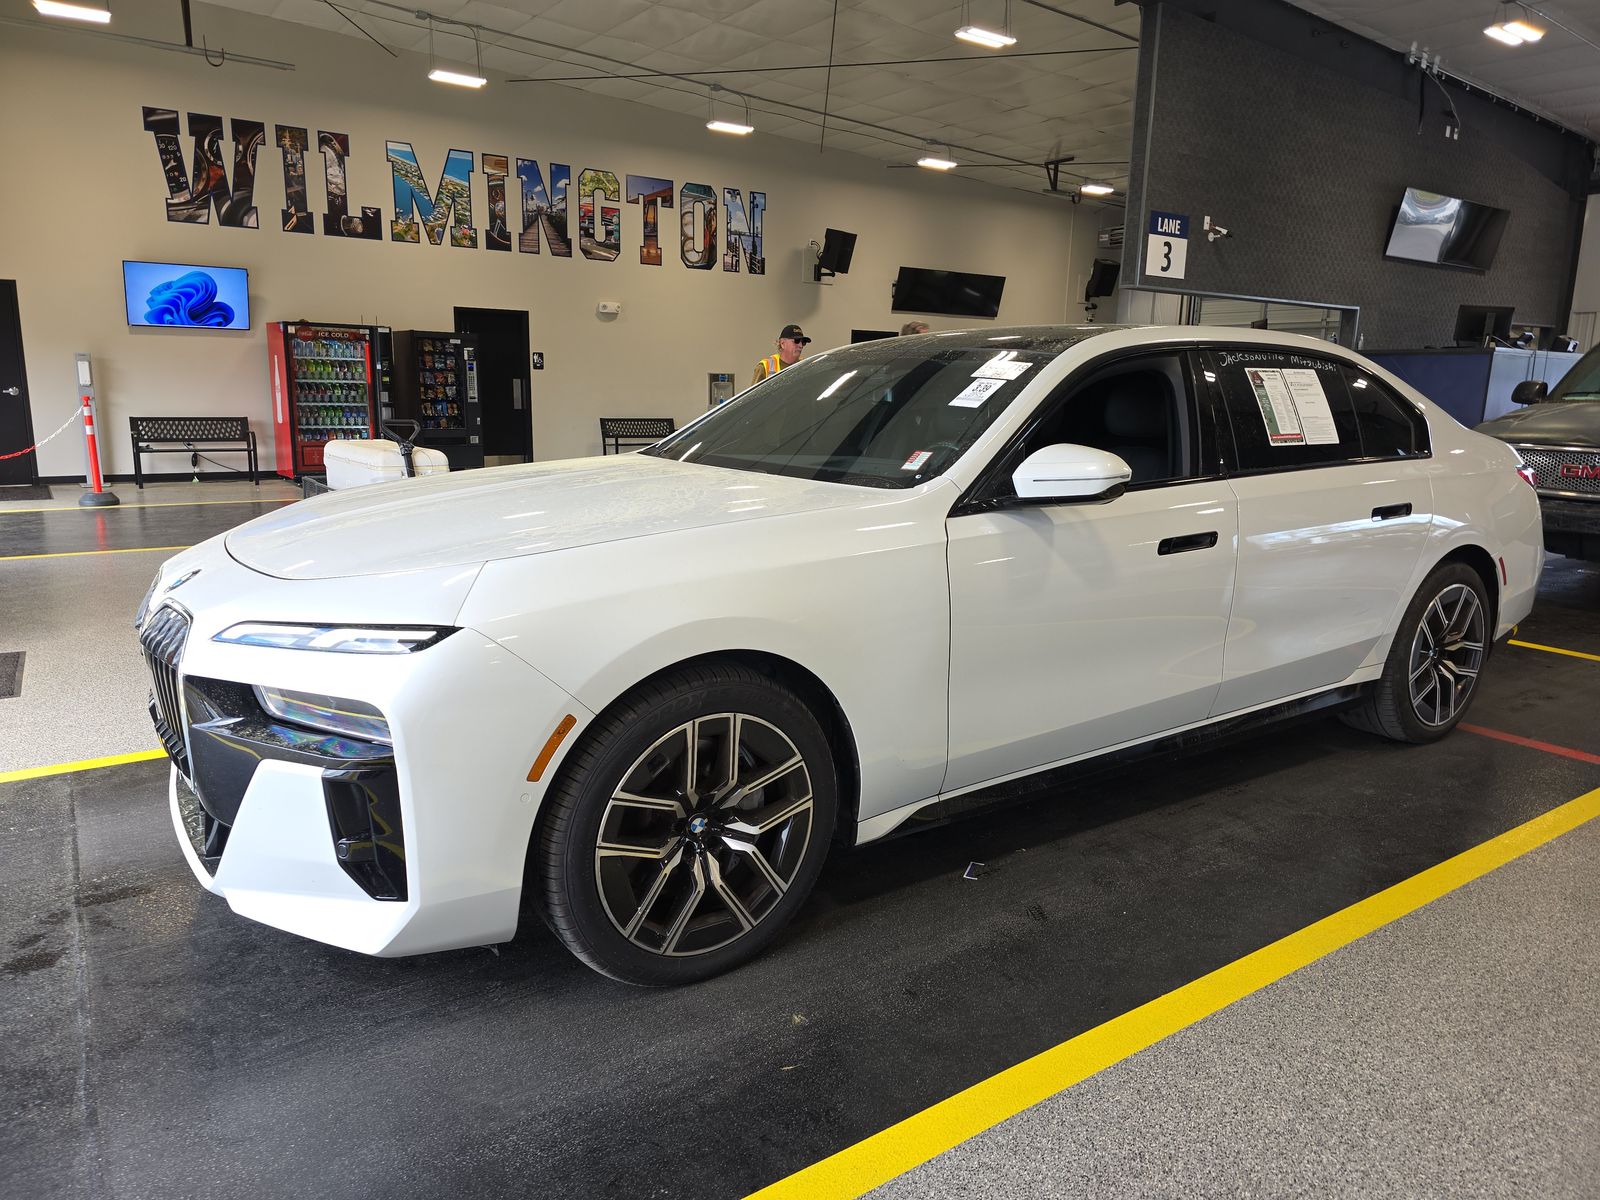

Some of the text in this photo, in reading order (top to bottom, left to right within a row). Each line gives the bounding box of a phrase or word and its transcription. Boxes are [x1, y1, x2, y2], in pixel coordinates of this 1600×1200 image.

[141, 106, 766, 275] WILMINGTON
[1157, 216, 1181, 235] LANE
[1160, 241, 1173, 273] 3
